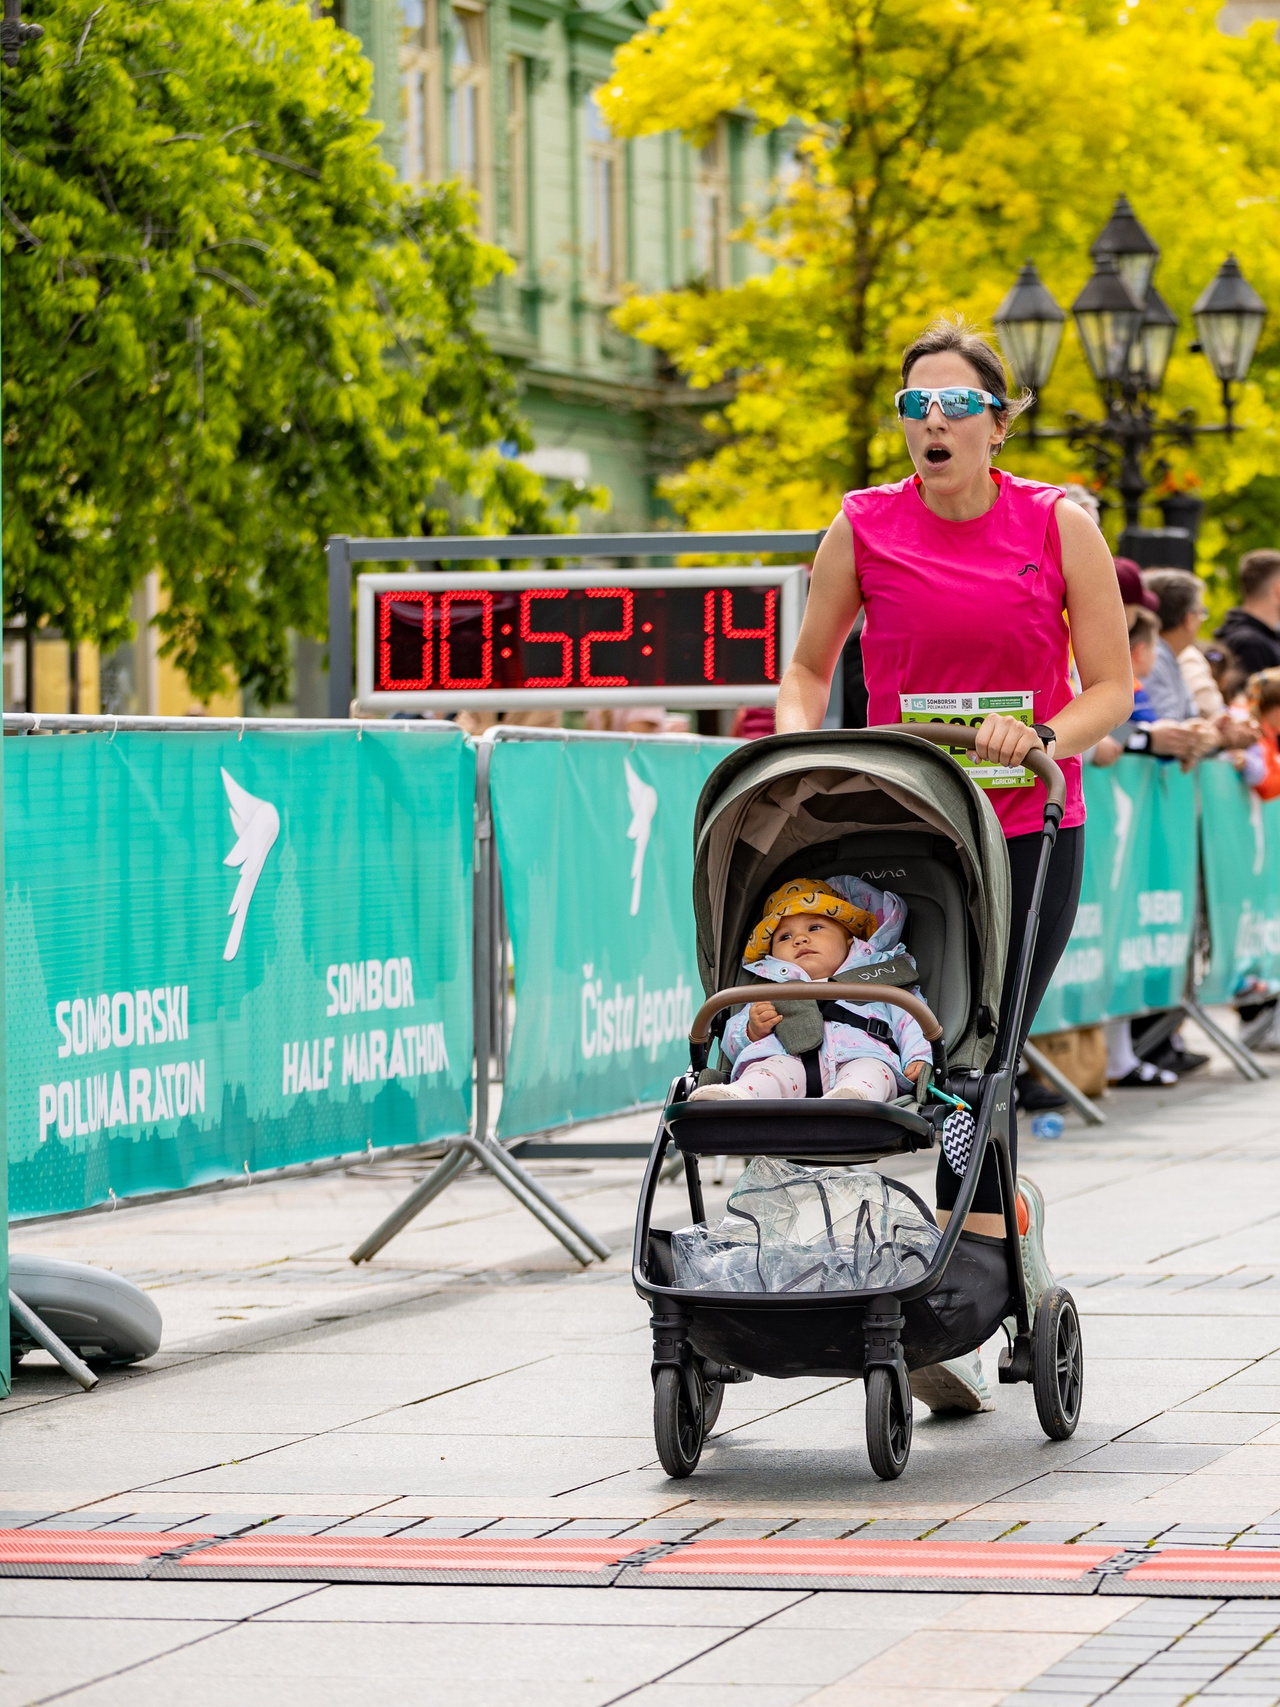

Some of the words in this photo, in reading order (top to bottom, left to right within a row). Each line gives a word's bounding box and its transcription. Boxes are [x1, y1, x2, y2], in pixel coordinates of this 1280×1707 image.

[861, 869, 906, 879] nuna
[55, 985, 188, 1058] SOMBORSKI
[326, 956, 415, 1017] SOMBOR
[581, 962, 635, 1060] Čista
[282, 1036, 335, 1096] HALF
[341, 1022, 450, 1086] MARATHON
